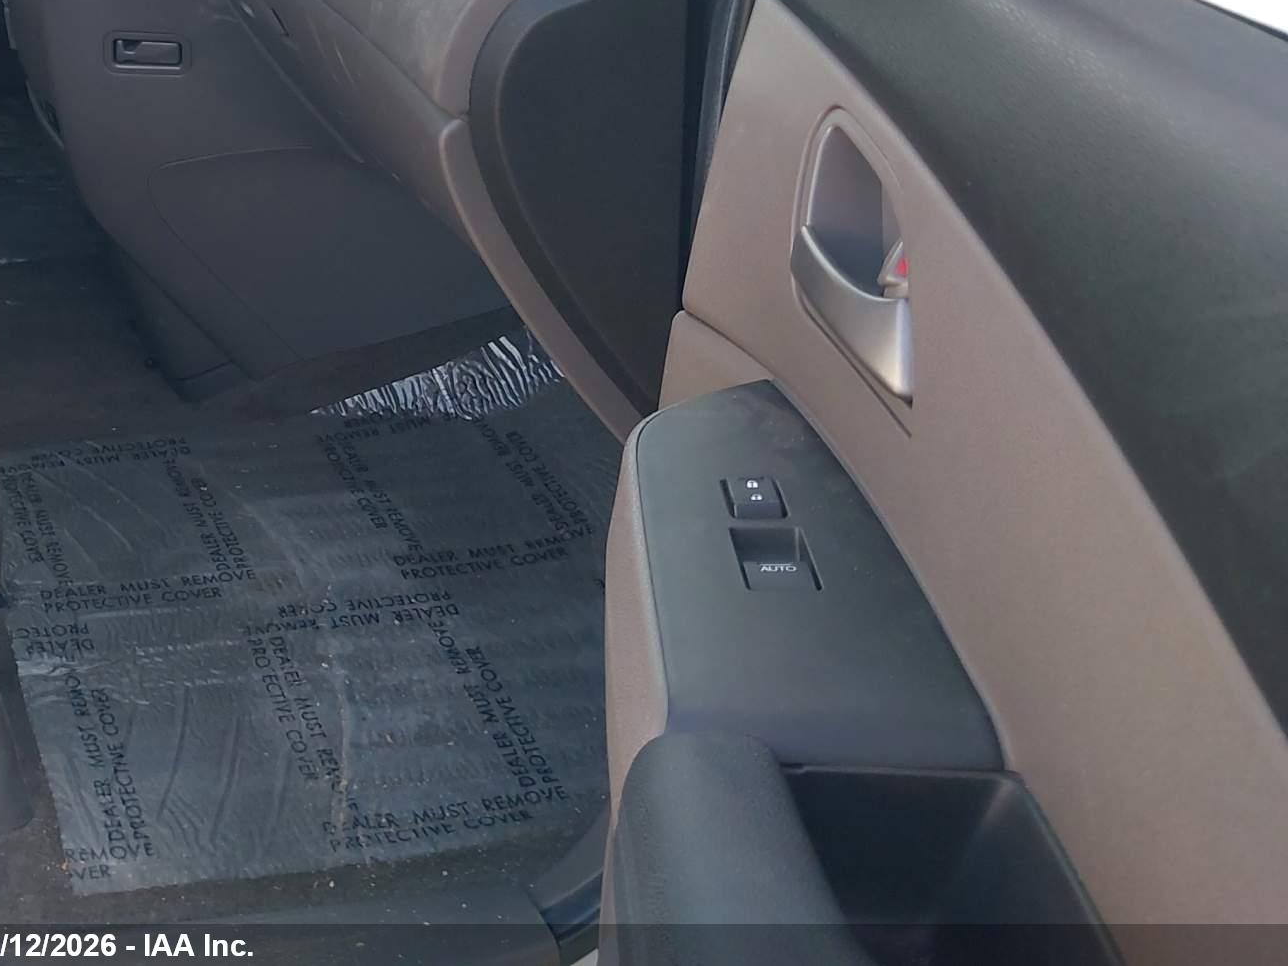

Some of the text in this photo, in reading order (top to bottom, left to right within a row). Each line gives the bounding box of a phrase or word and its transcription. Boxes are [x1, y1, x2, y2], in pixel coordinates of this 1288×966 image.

[199, 532, 232, 571] DEALER
[393, 550, 458, 567] DEALER
[467, 543, 516, 559] MUST
[400, 546, 569, 581] PROTECTIVE COVER
[759, 563, 797, 572] AUTO
[40, 569, 257, 601] DEALER MUST REMOVE
[43, 586, 223, 614] PROTECTIVE COVER
[346, 590, 452, 611] PROTECTIVE
[331, 611, 380, 629] MUST
[393, 603, 460, 622] DEALER
[247, 637, 296, 724] PROECTIVE
[294, 695, 327, 739] MUST
[428, 619, 537, 788] DEALER MUST REMOVE
[465, 645, 560, 784] PROTECTIVE COVER
[78, 725, 105, 769] MUST
[94, 777, 126, 842] DEALER
[108, 742, 151, 840] PROTECTIVE
[413, 802, 470, 825] MUST
[481, 785, 571, 812] REMOVE
[329, 809, 534, 852] PROTECTIVE COVER
[64, 842, 155, 862] REMOVE
[70, 864, 112, 881] VER
